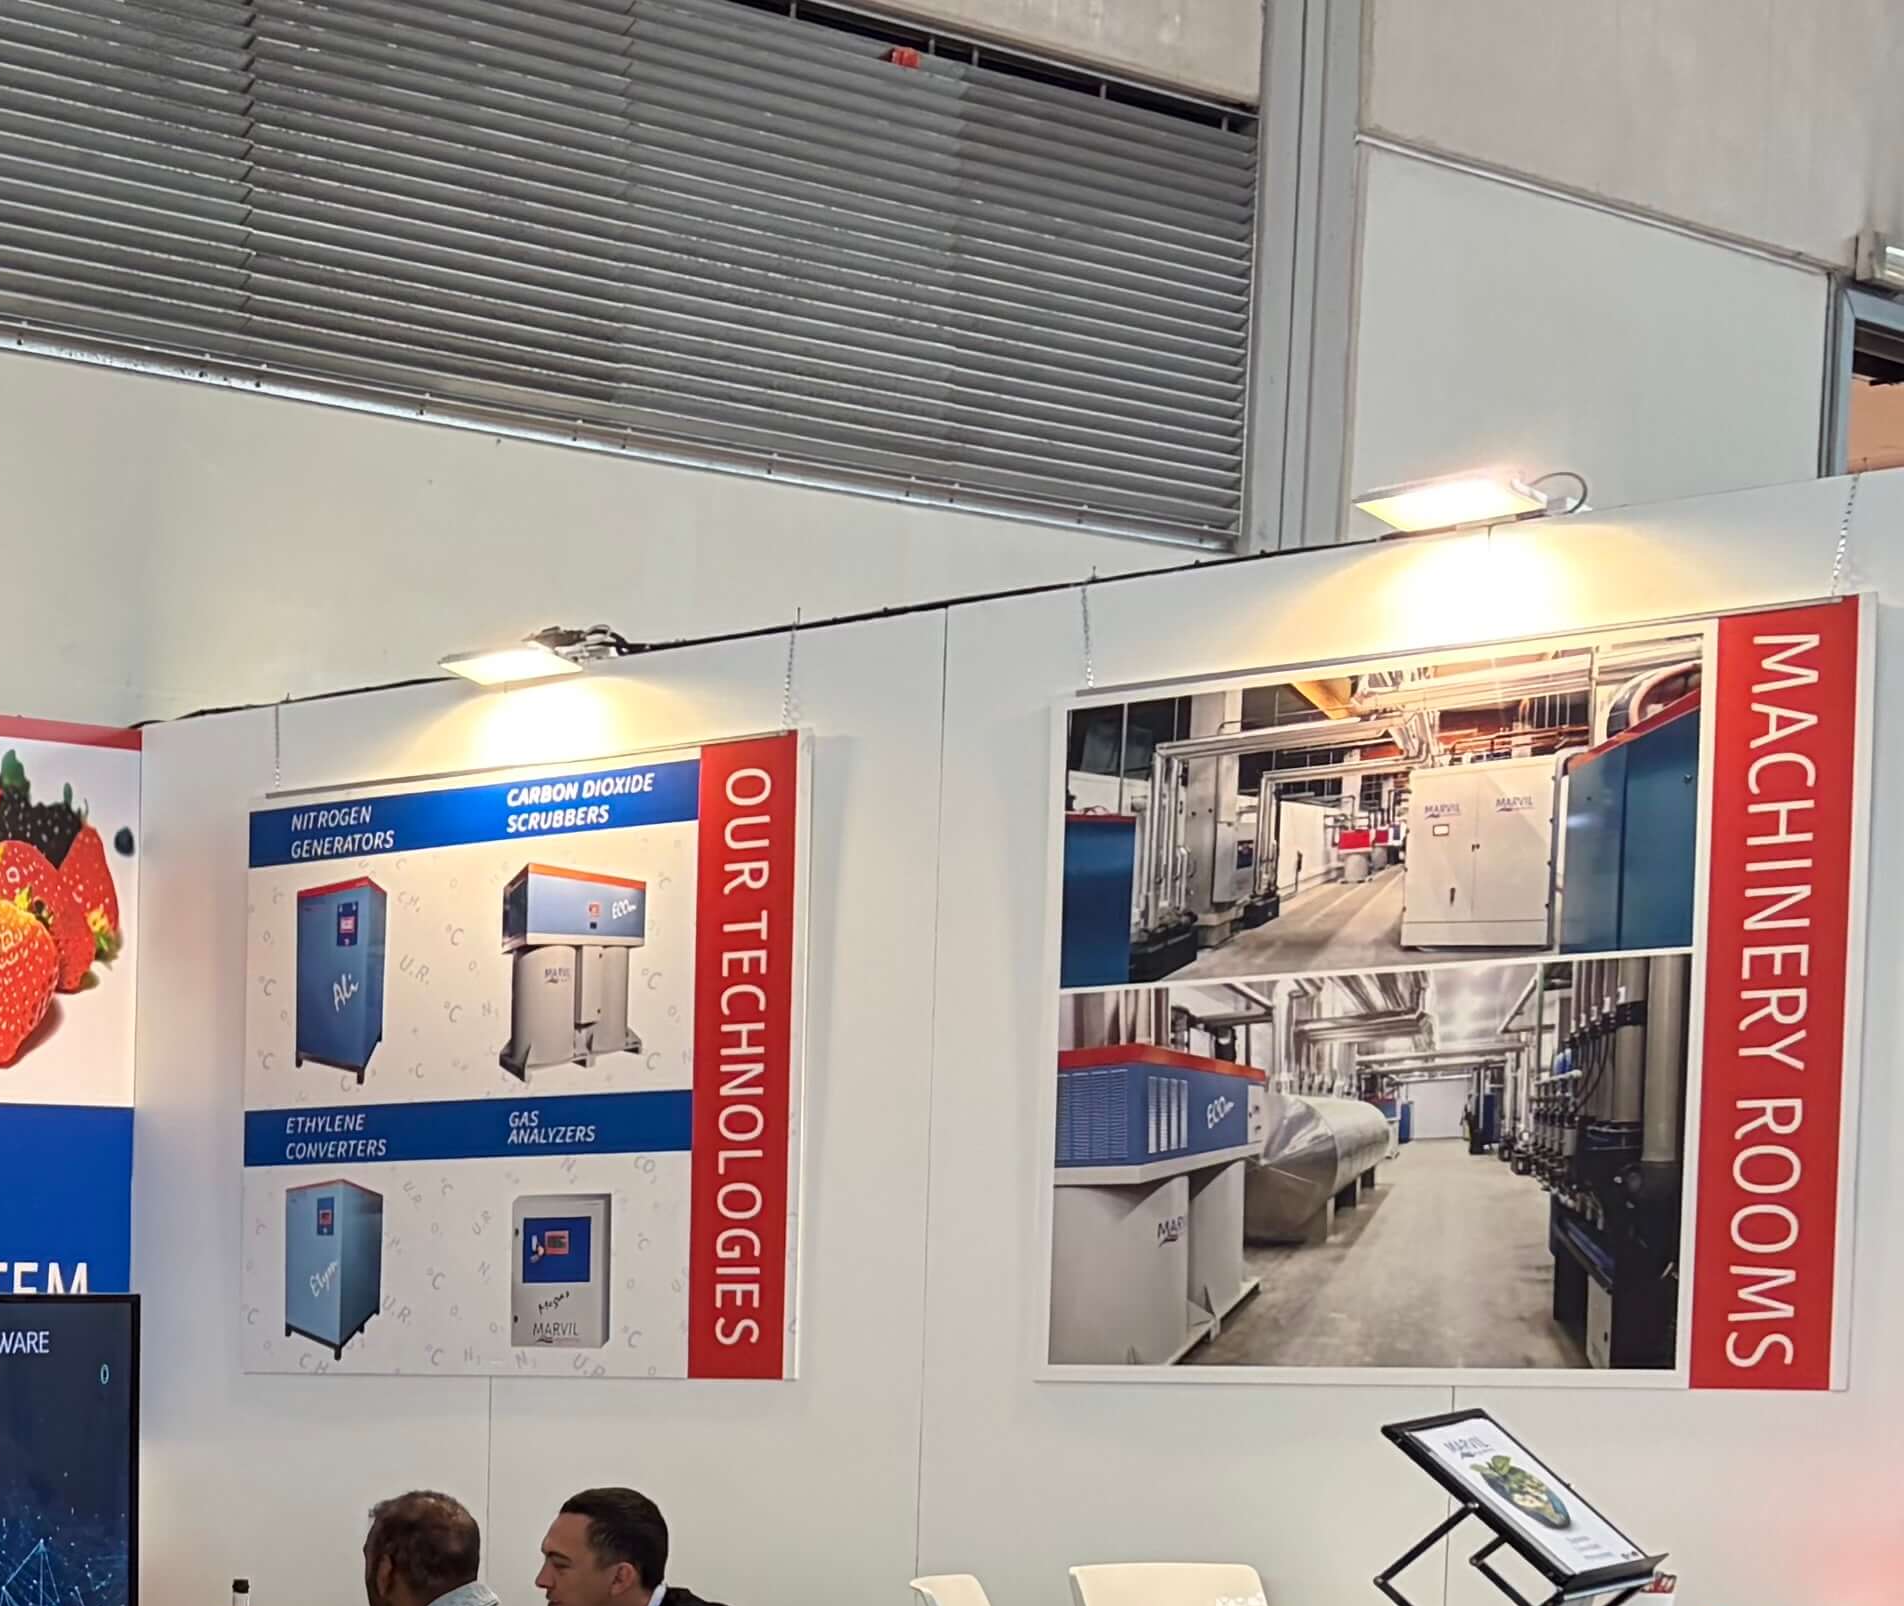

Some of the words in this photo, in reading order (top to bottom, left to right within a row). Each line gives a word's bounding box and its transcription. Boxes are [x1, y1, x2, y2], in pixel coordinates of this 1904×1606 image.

[506, 780, 578, 808] CARBON
[581, 772, 655, 798] DIOXIDE
[291, 806, 372, 832] NITROGEN
[506, 805, 610, 833] SCRUBBERS
[724, 767, 772, 896] OUR
[291, 830, 394, 859] GENERATORS
[1737, 632, 1820, 1072] MACHINERY
[286, 1114, 366, 1134] ETHYLENE
[508, 1111, 540, 1128] GAS
[715, 910, 768, 1347] TECHNOLOGIES
[507, 1125, 596, 1145] ANALYZERS
[286, 1139, 387, 1160] CONVERTERS
[1725, 1097, 1804, 1368] ROOMS
[533, 1322, 579, 1336] MARVIL
